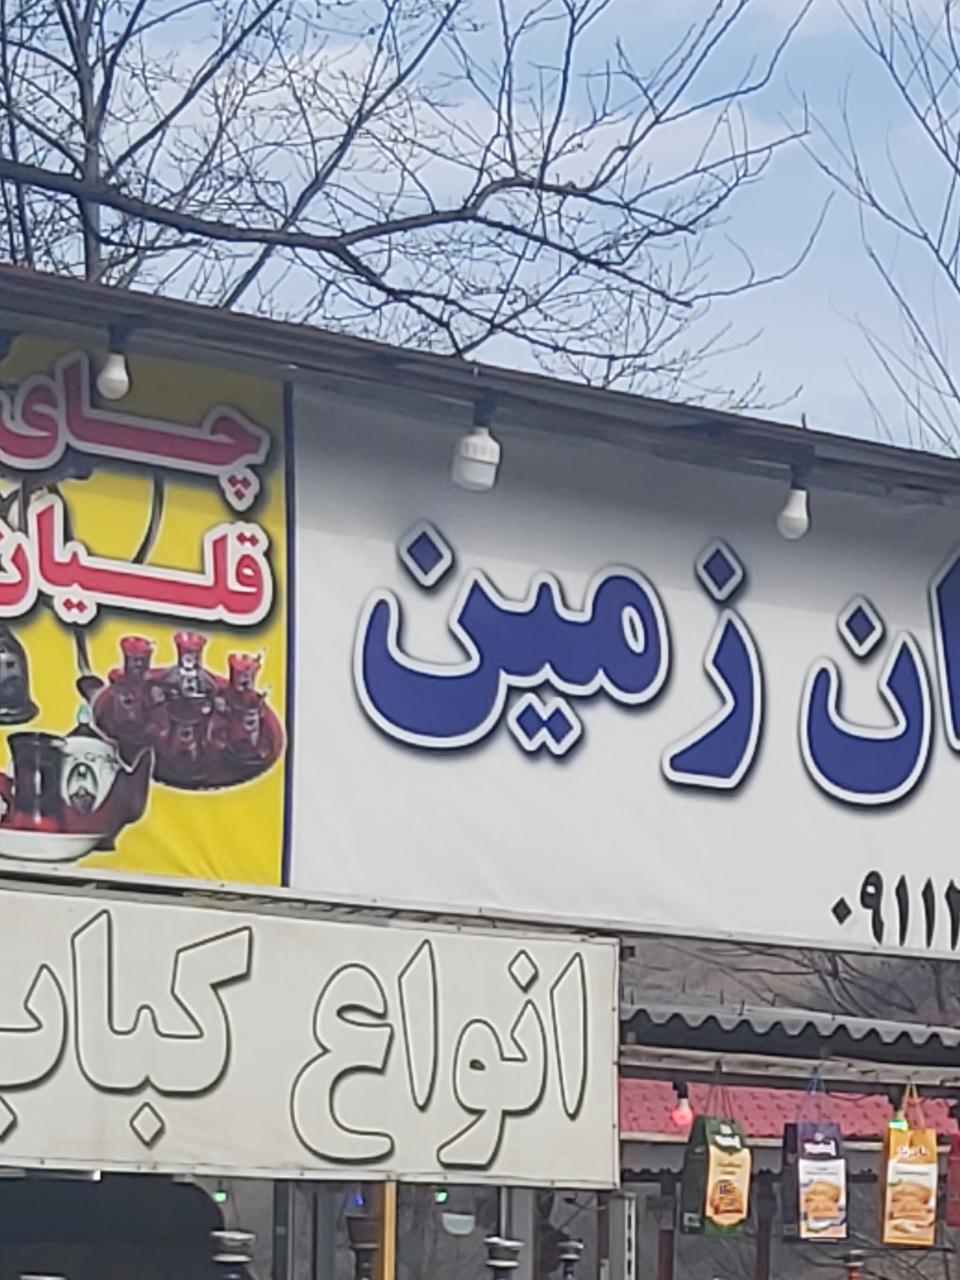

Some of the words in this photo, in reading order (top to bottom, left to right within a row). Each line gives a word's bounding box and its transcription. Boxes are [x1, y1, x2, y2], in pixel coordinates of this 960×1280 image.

[0, 357, 267, 503] چای
[359, 526, 760, 786] زمین
[290, 938, 588, 1169] انواع
